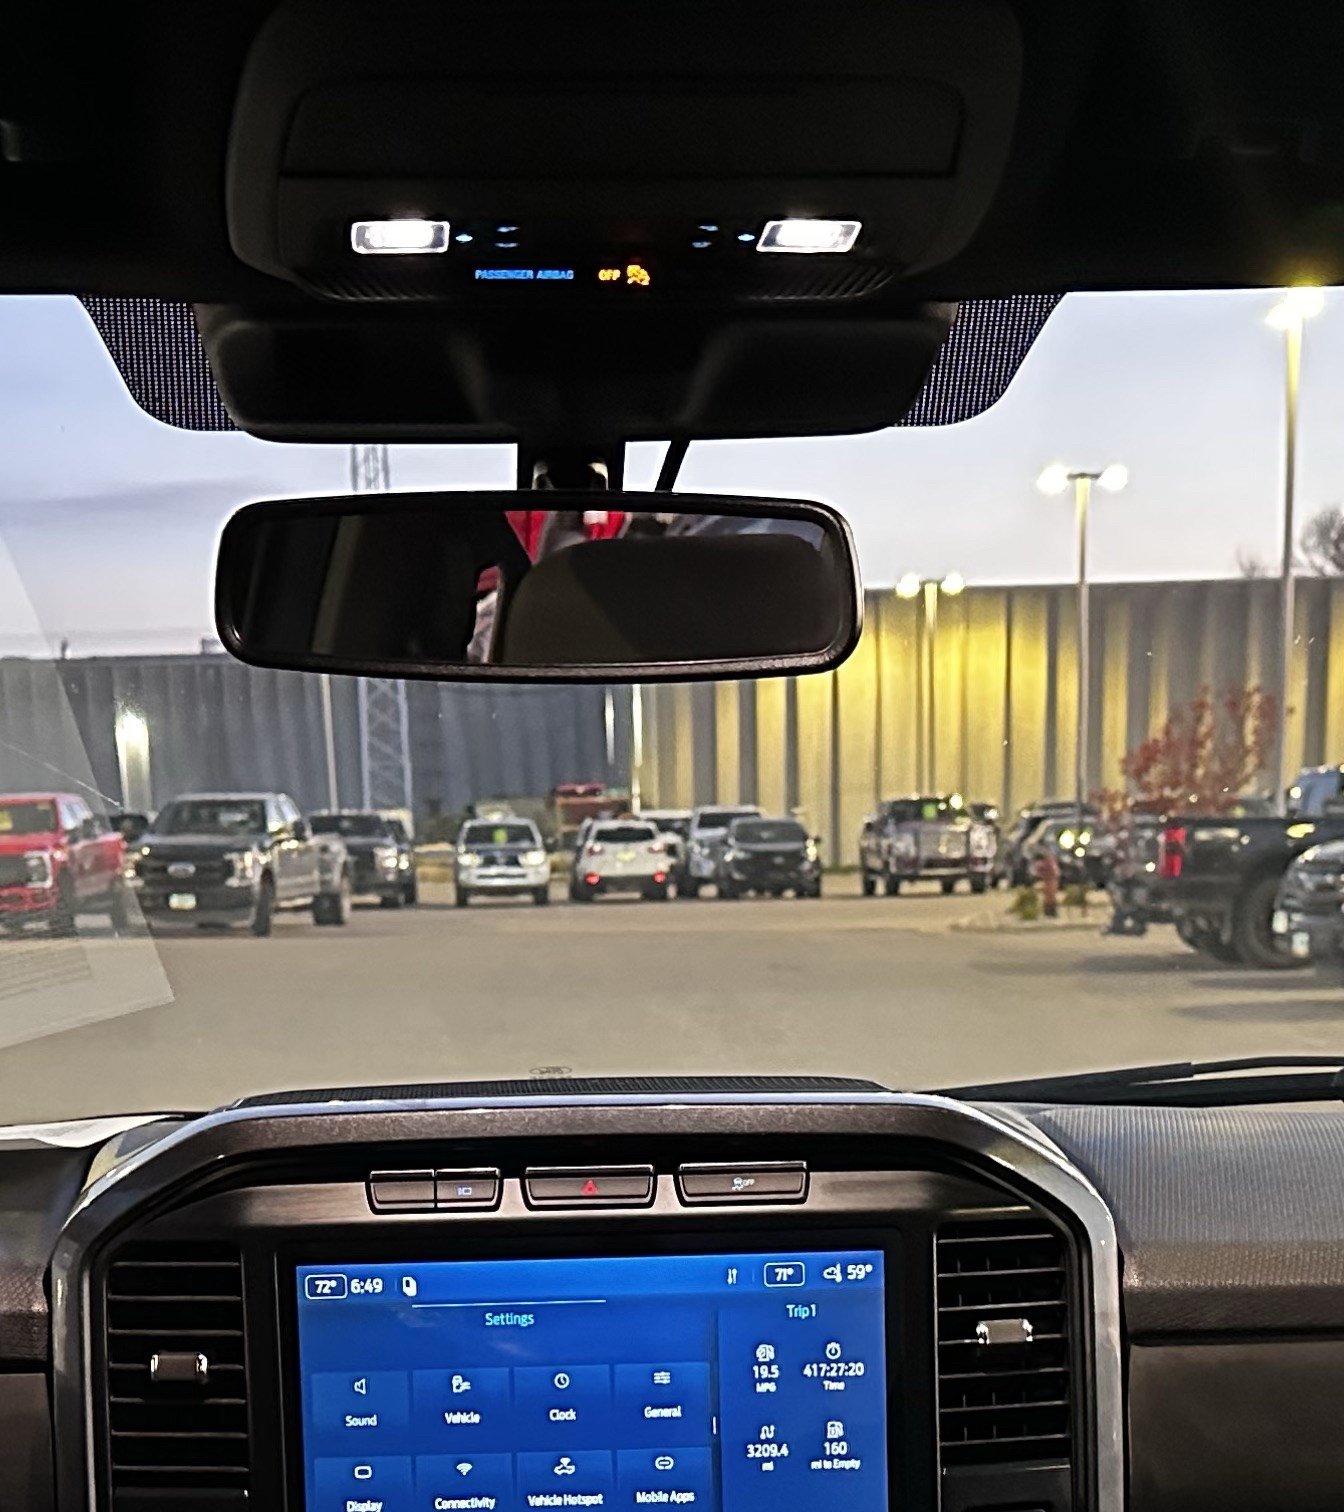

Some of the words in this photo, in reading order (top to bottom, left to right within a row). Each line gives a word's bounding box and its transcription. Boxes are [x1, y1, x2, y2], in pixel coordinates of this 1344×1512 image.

[474, 269, 534, 280] PASSENGER
[536, 269, 574, 280] AIRBAG
[598, 269, 621, 281] OFF
[846, 1263, 873, 1280] 59°
[350, 1278, 383, 1293] 6:49
[786, 1304, 808, 1319] Trip
[810, 1304, 816, 1317] 1
[485, 1312, 534, 1326] Settings
[753, 1365, 779, 1379] 19.5
[803, 1362, 864, 1377] 417:27:20
[756, 1382, 776, 1392] MPG
[823, 1380, 845, 1391] Time
[445, 1412, 481, 1424] Vehicle
[549, 1409, 576, 1421] Clock
[644, 1405, 682, 1418] General
[345, 1415, 377, 1427] Sound
[747, 1443, 789, 1457] 3209.4
[824, 1441, 847, 1455] 160
[823, 1460, 832, 1469] to
[833, 1458, 861, 1470] Empty
[528, 1494, 562, 1507] Vehicle
[564, 1494, 603, 1507] Hotspot
[636, 1491, 668, 1503] Mobile
[670, 1490, 694, 1503] Apps
[435, 1497, 496, 1510] Connectivity
